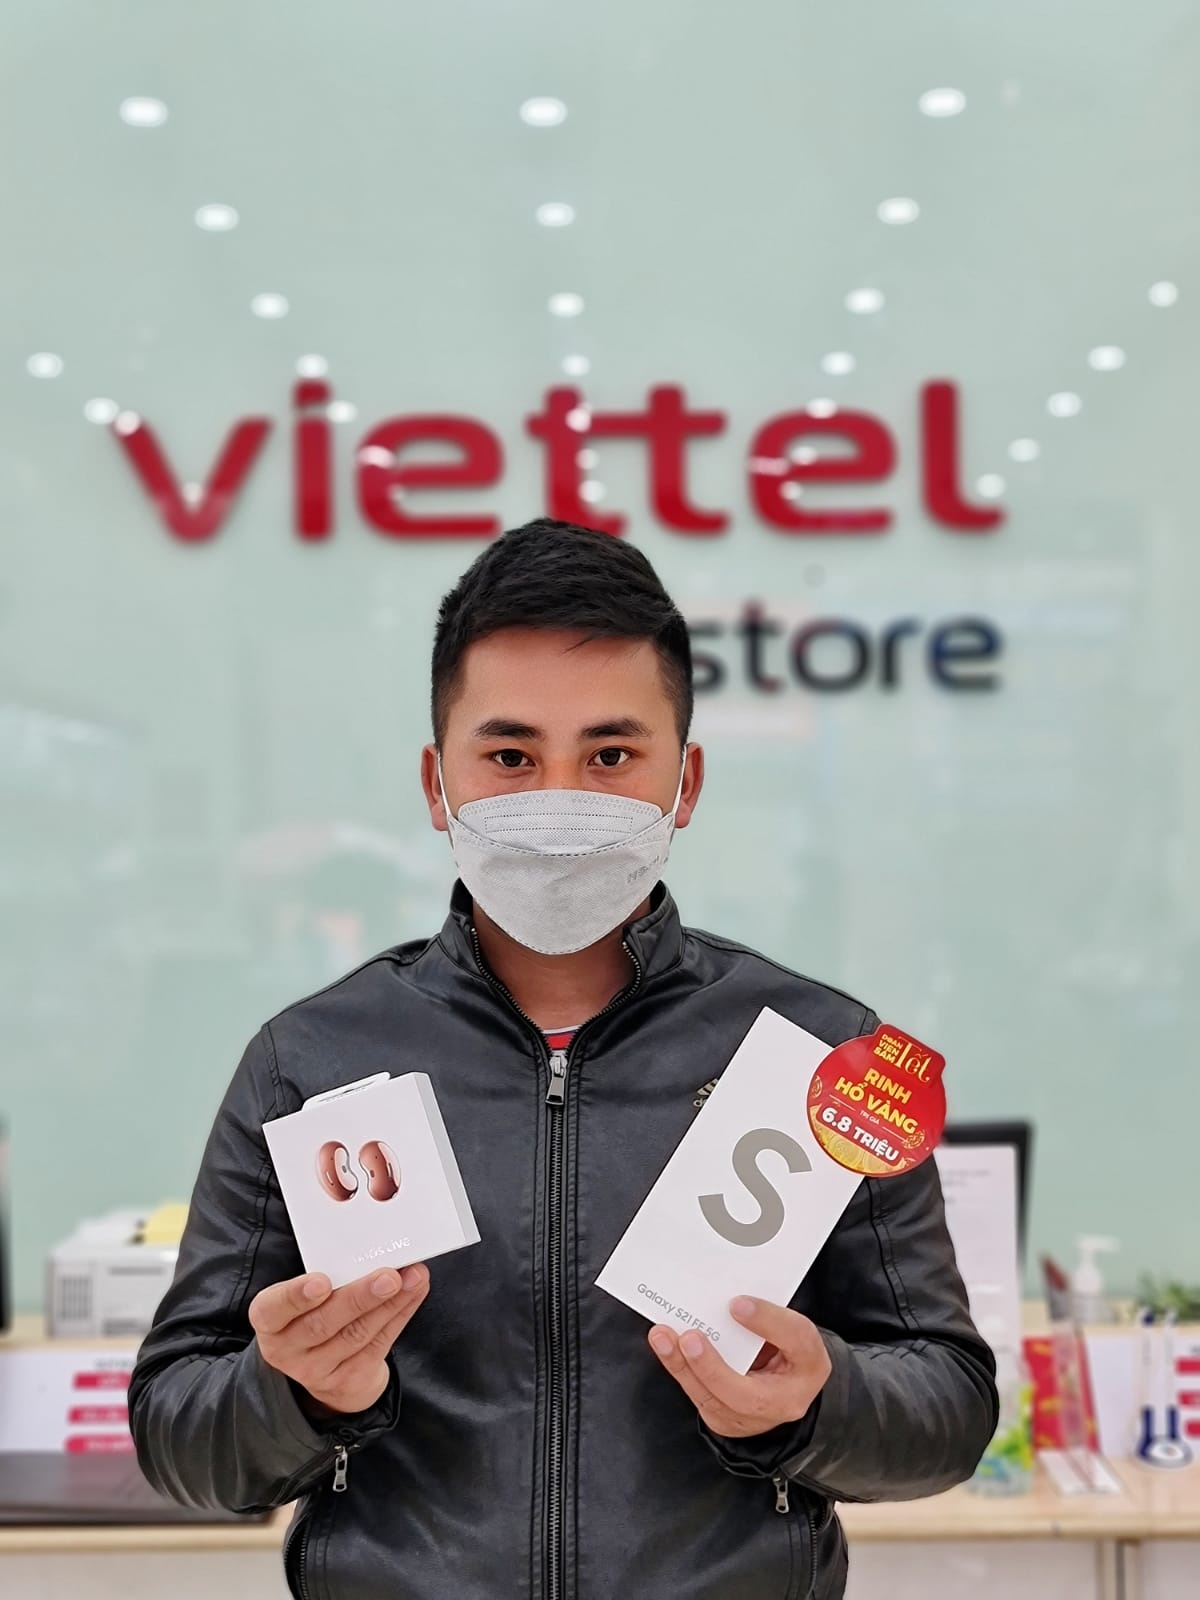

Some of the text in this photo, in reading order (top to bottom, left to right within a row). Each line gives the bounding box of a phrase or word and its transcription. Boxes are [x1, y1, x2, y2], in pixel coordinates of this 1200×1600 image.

[112, 378, 1007, 543] viettel
[864, 1068, 912, 1104] RINH
[822, 1107, 899, 1161] 6.8 TRIỆU
[867, 1095, 918, 1134] VÀNG
[697, 1128, 812, 1247] S
[637, 1283, 721, 1342] Galaxy S21 FE 5G
